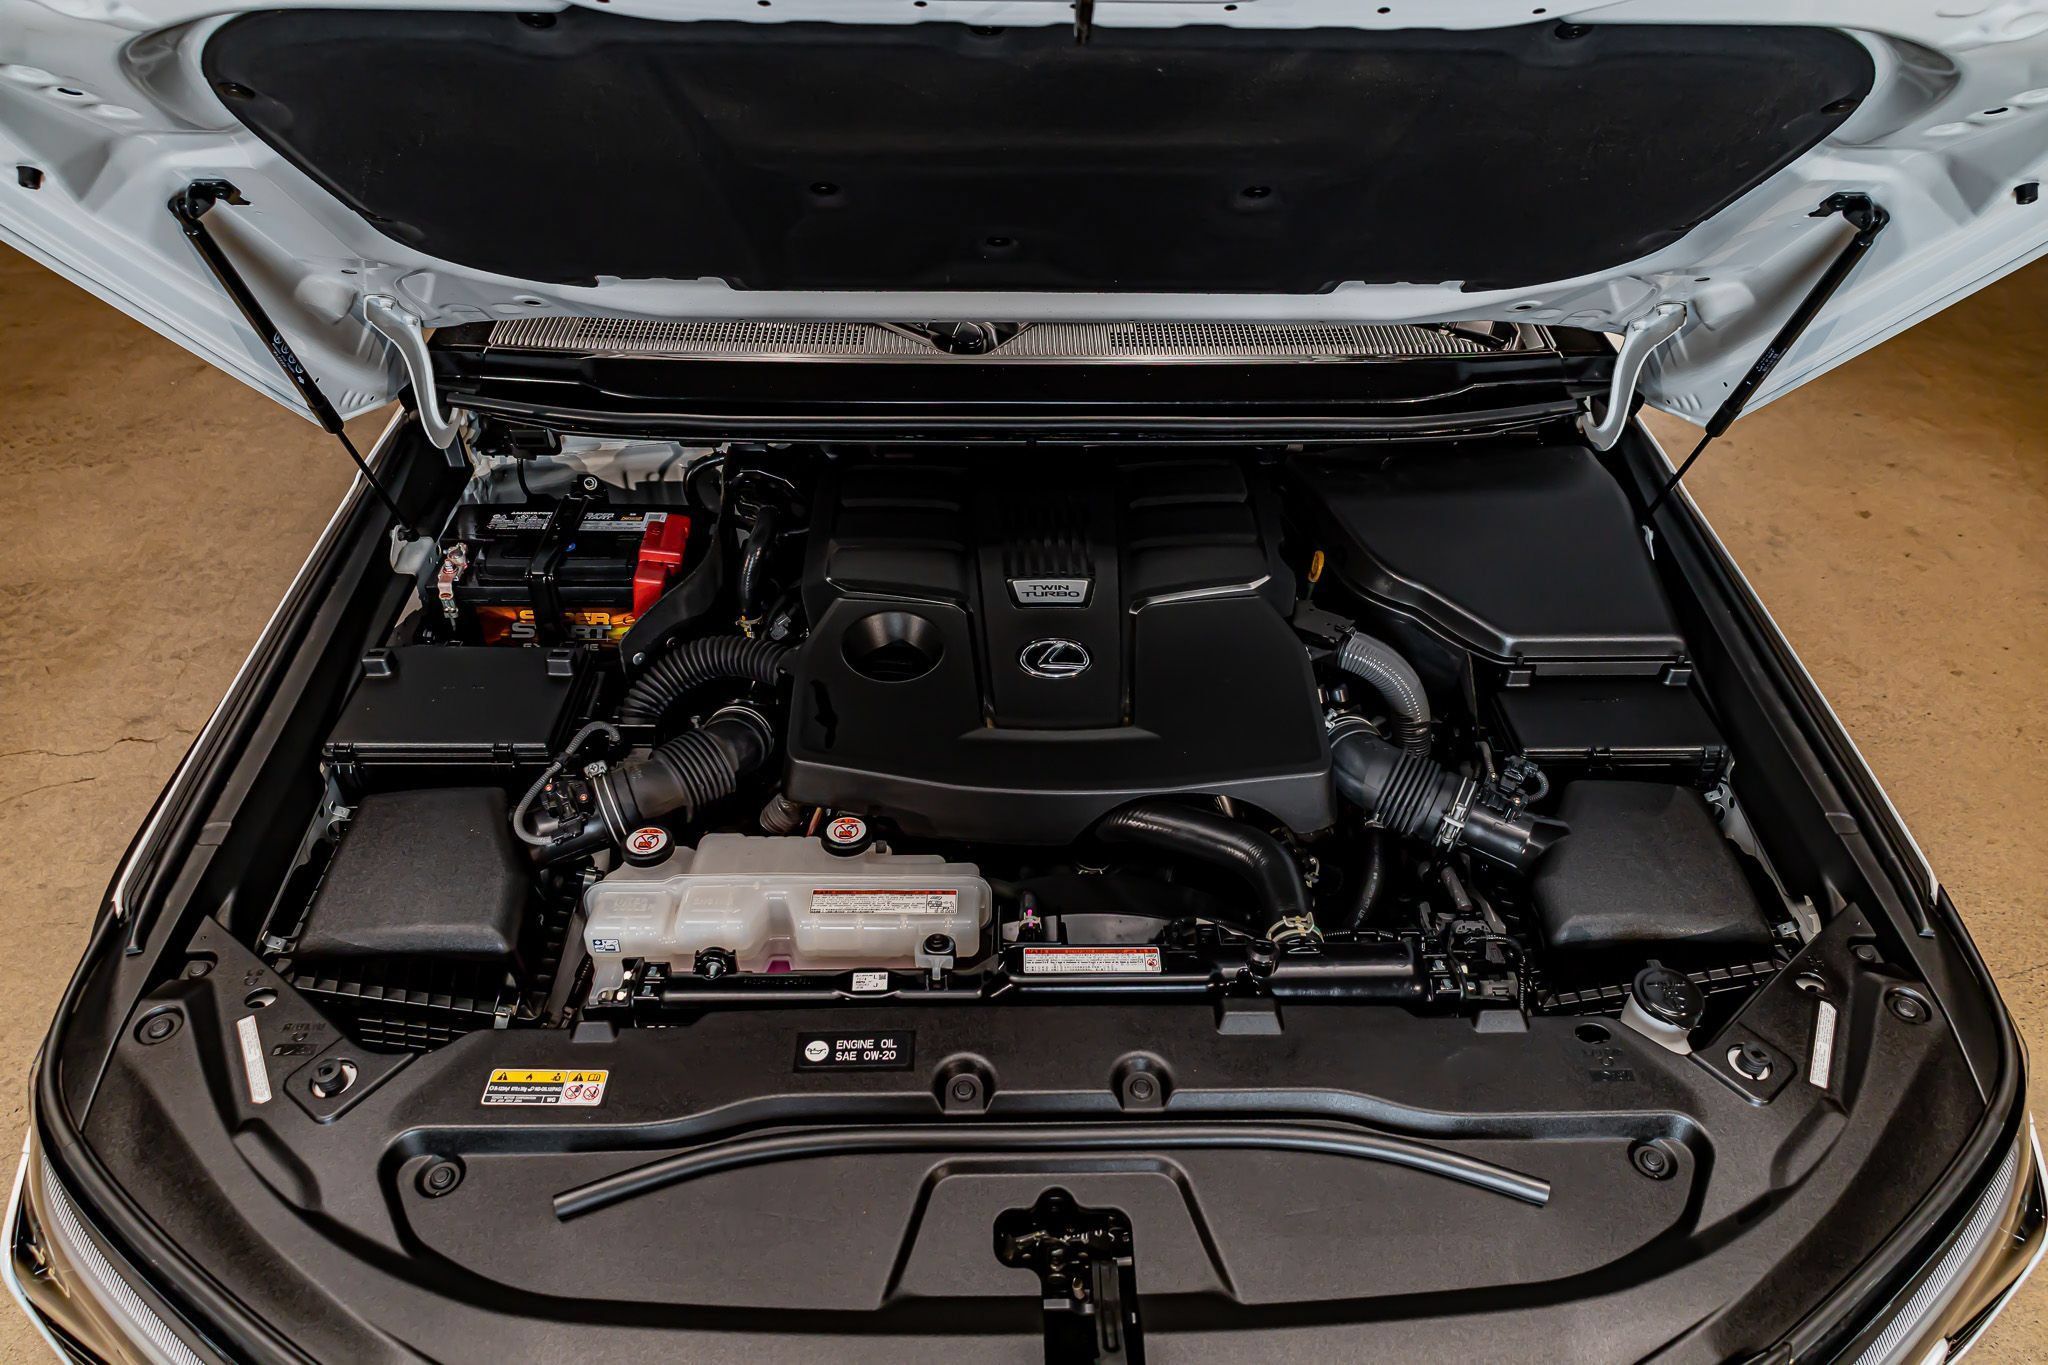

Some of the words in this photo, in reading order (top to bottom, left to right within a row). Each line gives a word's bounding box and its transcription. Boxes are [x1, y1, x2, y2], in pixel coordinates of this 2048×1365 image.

[836, 1039, 875, 1050] ENGINE
[880, 1038, 898, 1049] OIL
[835, 1051, 857, 1061] SAE
